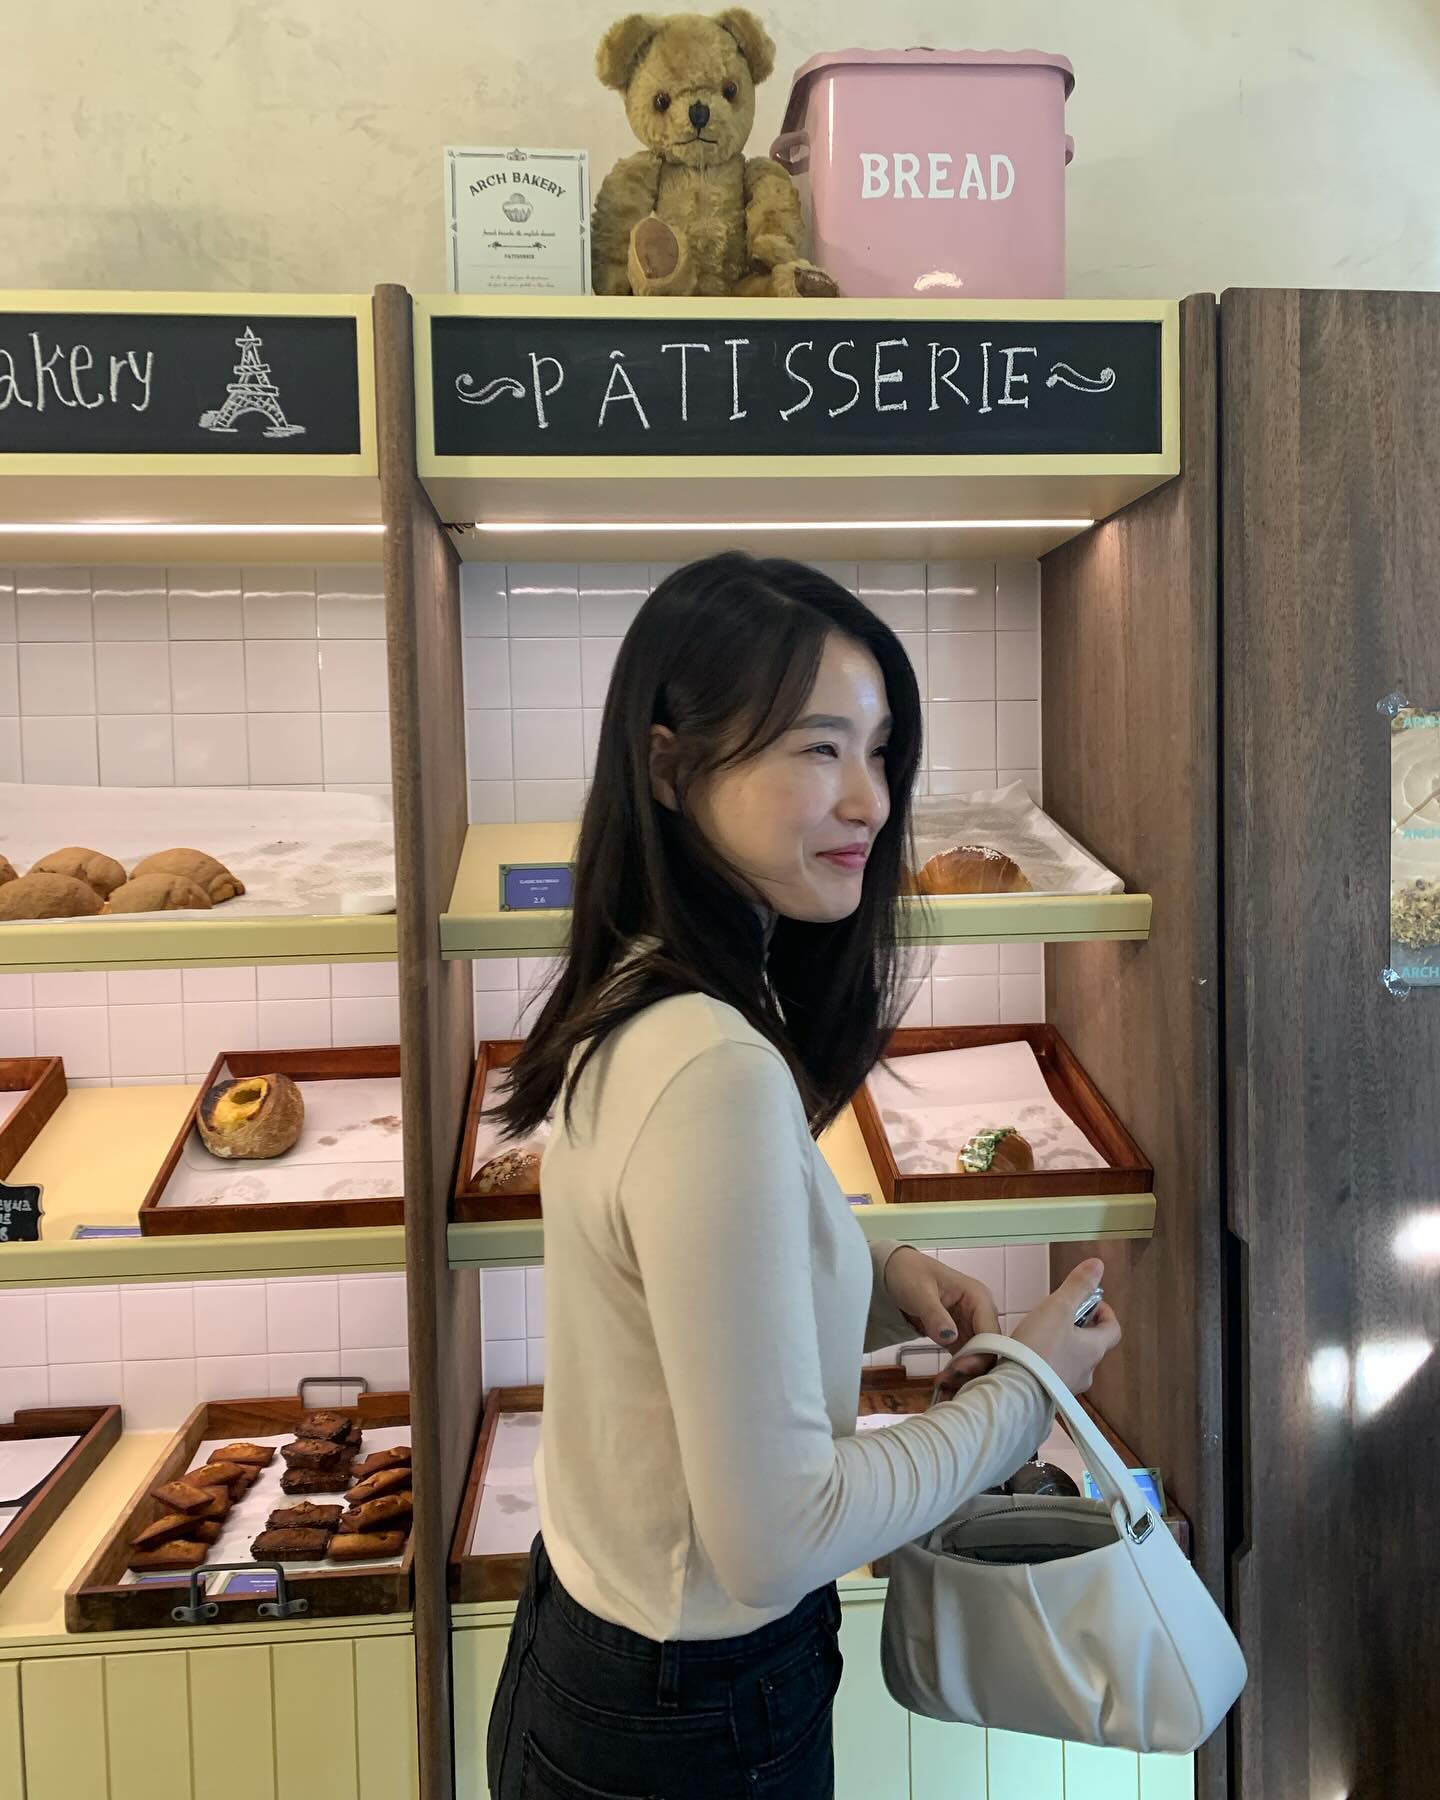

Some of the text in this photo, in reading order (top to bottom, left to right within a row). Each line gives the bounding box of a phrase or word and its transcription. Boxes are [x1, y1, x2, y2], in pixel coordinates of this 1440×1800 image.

[469, 171, 567, 198] ARCH BAKERY
[859, 152, 1015, 200] BREAD
